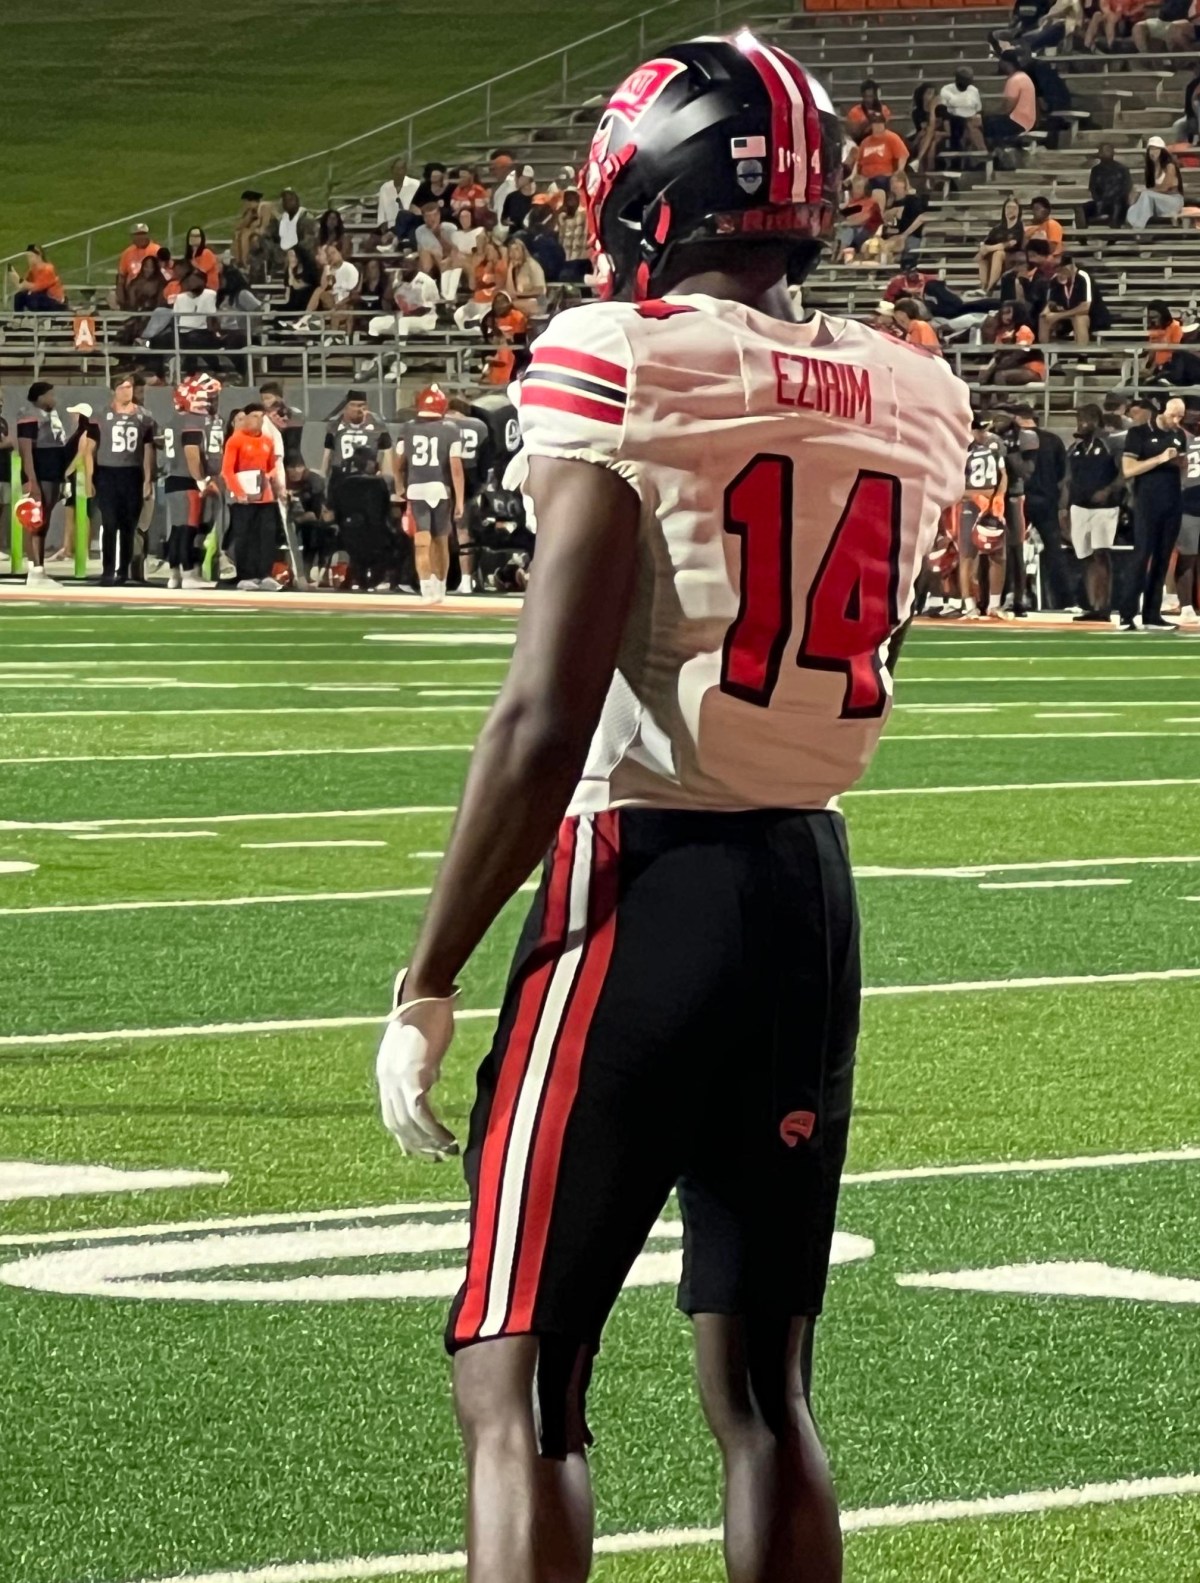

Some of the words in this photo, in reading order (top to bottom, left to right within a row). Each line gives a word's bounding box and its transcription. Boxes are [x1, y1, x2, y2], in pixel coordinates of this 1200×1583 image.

[75, 319, 94, 346] A
[771, 350, 872, 425] EZIRIM
[411, 434, 440, 466] 31
[720, 452, 902, 719] 14
